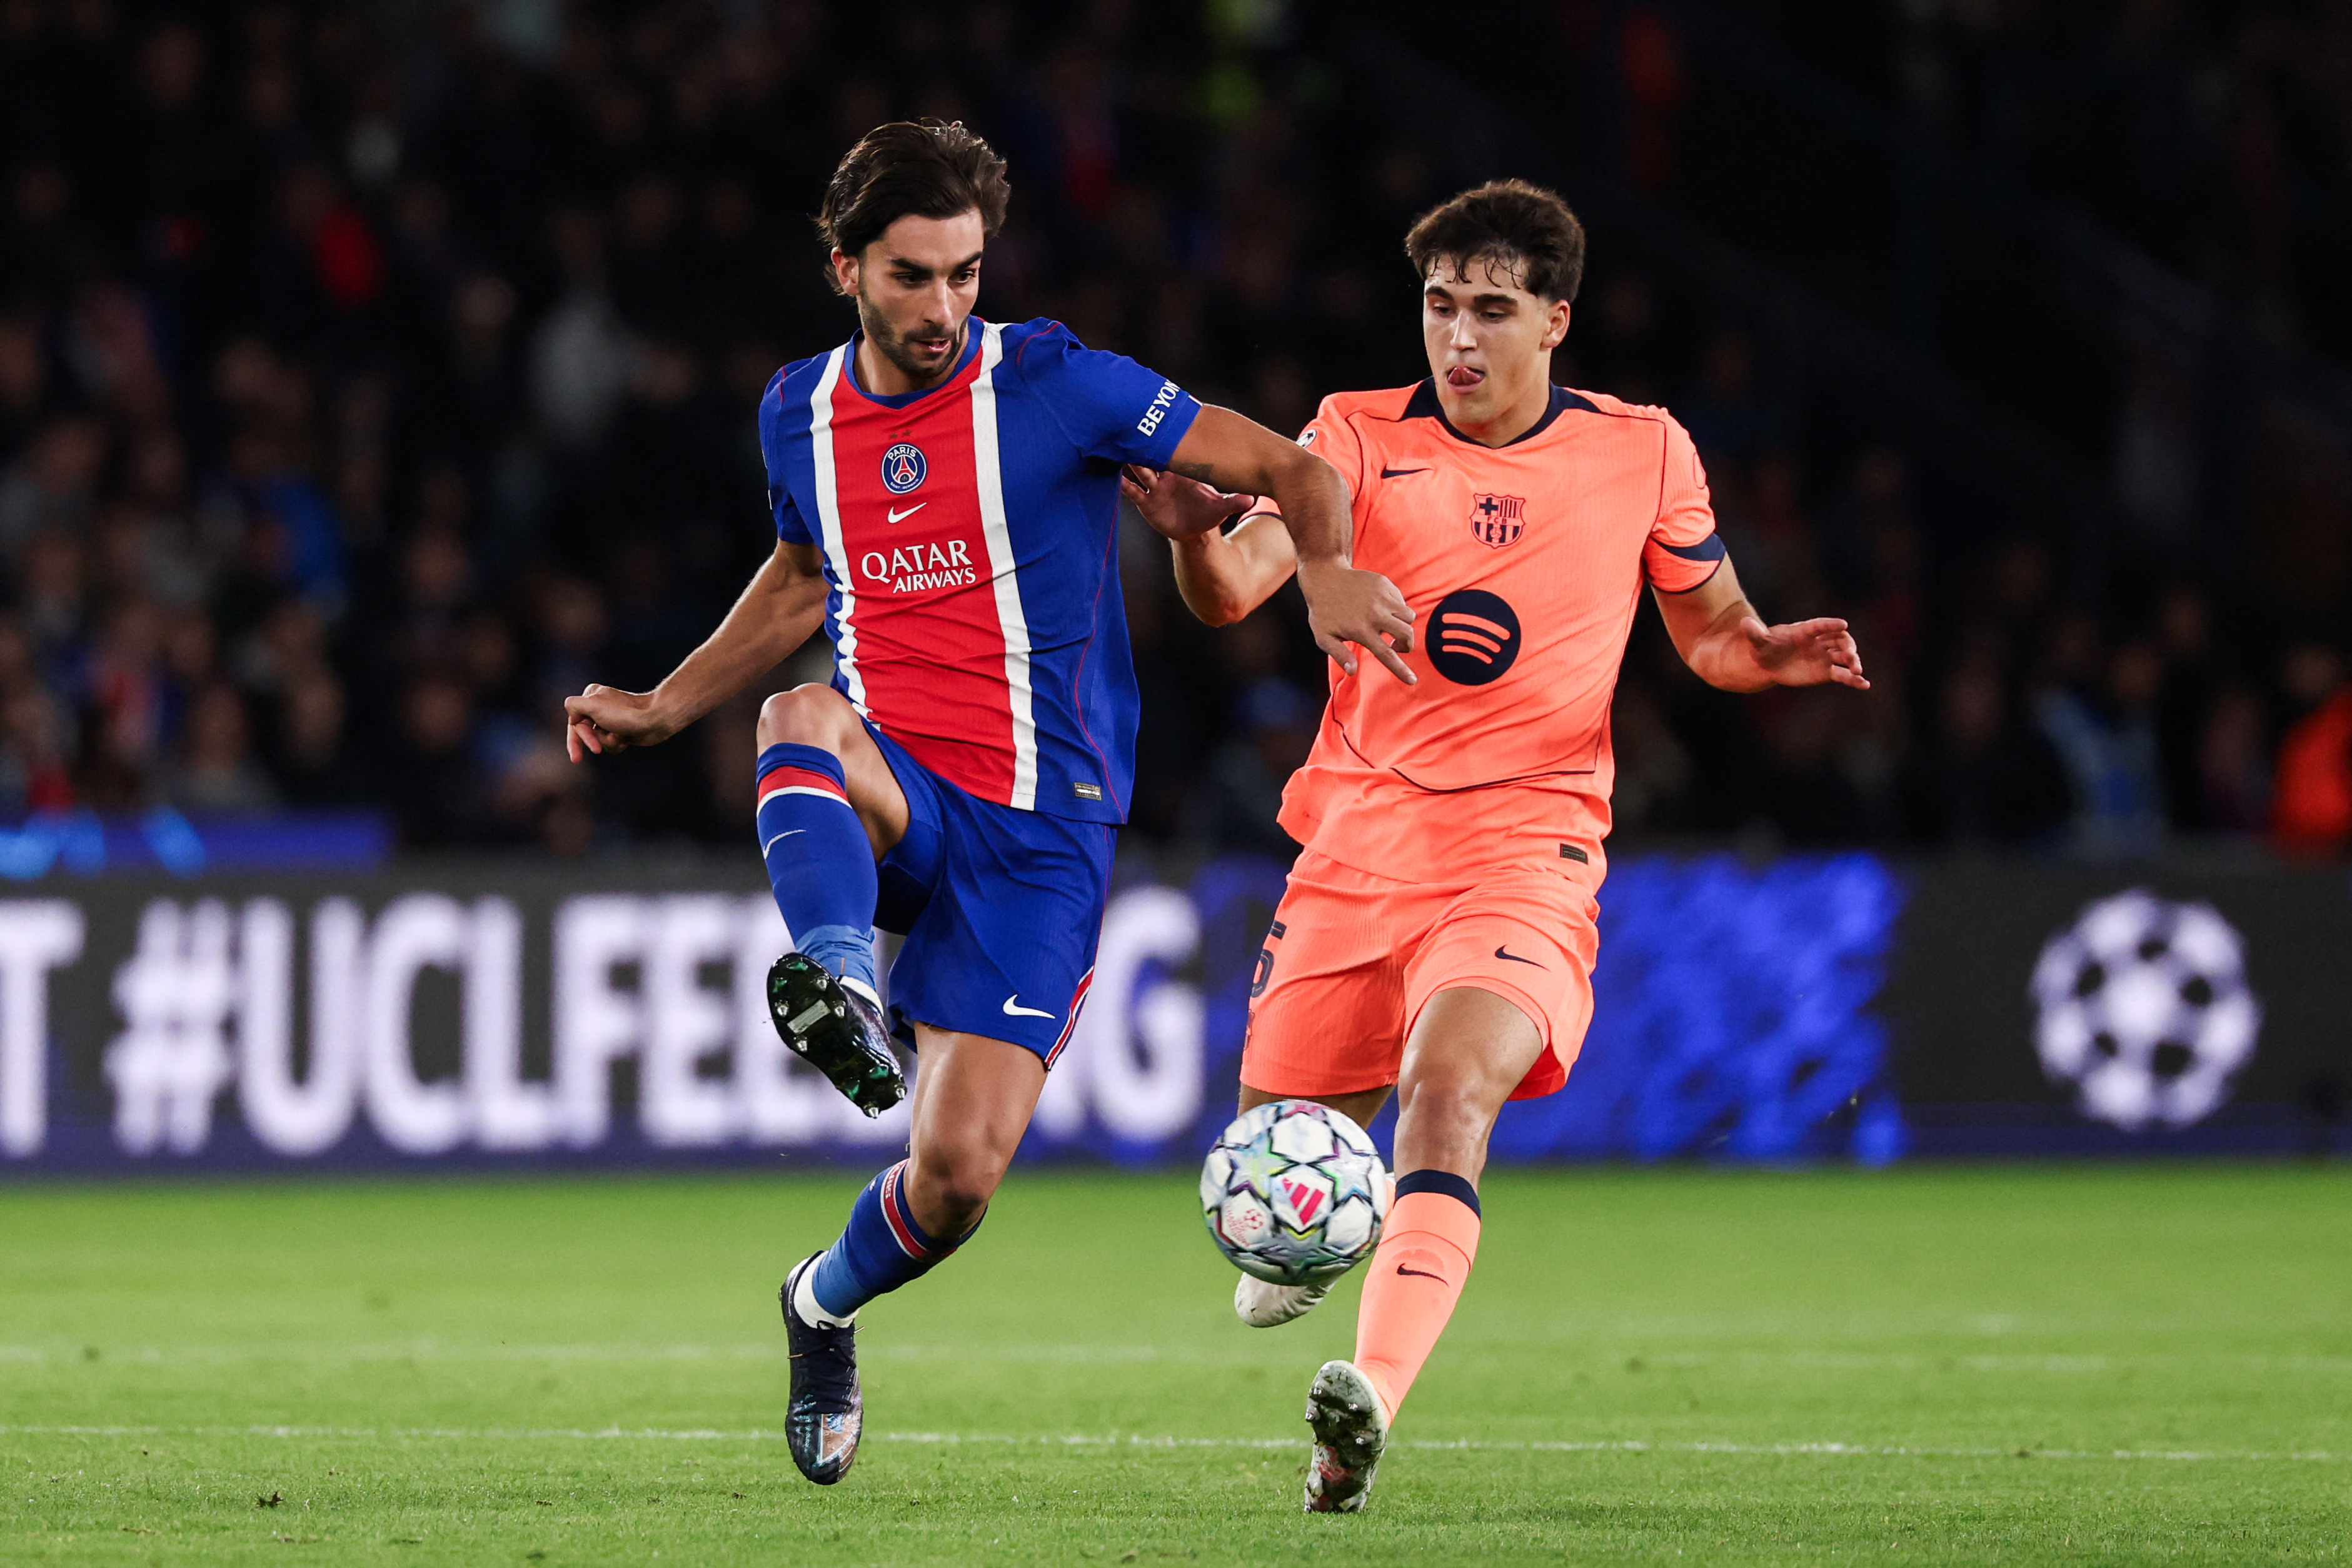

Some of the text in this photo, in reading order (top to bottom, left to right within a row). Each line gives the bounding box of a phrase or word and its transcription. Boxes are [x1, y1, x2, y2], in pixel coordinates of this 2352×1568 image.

[887, 446, 917, 461] PARIS
[861, 540, 973, 584] QATAR
[892, 567, 977, 594] AIRWAYS
